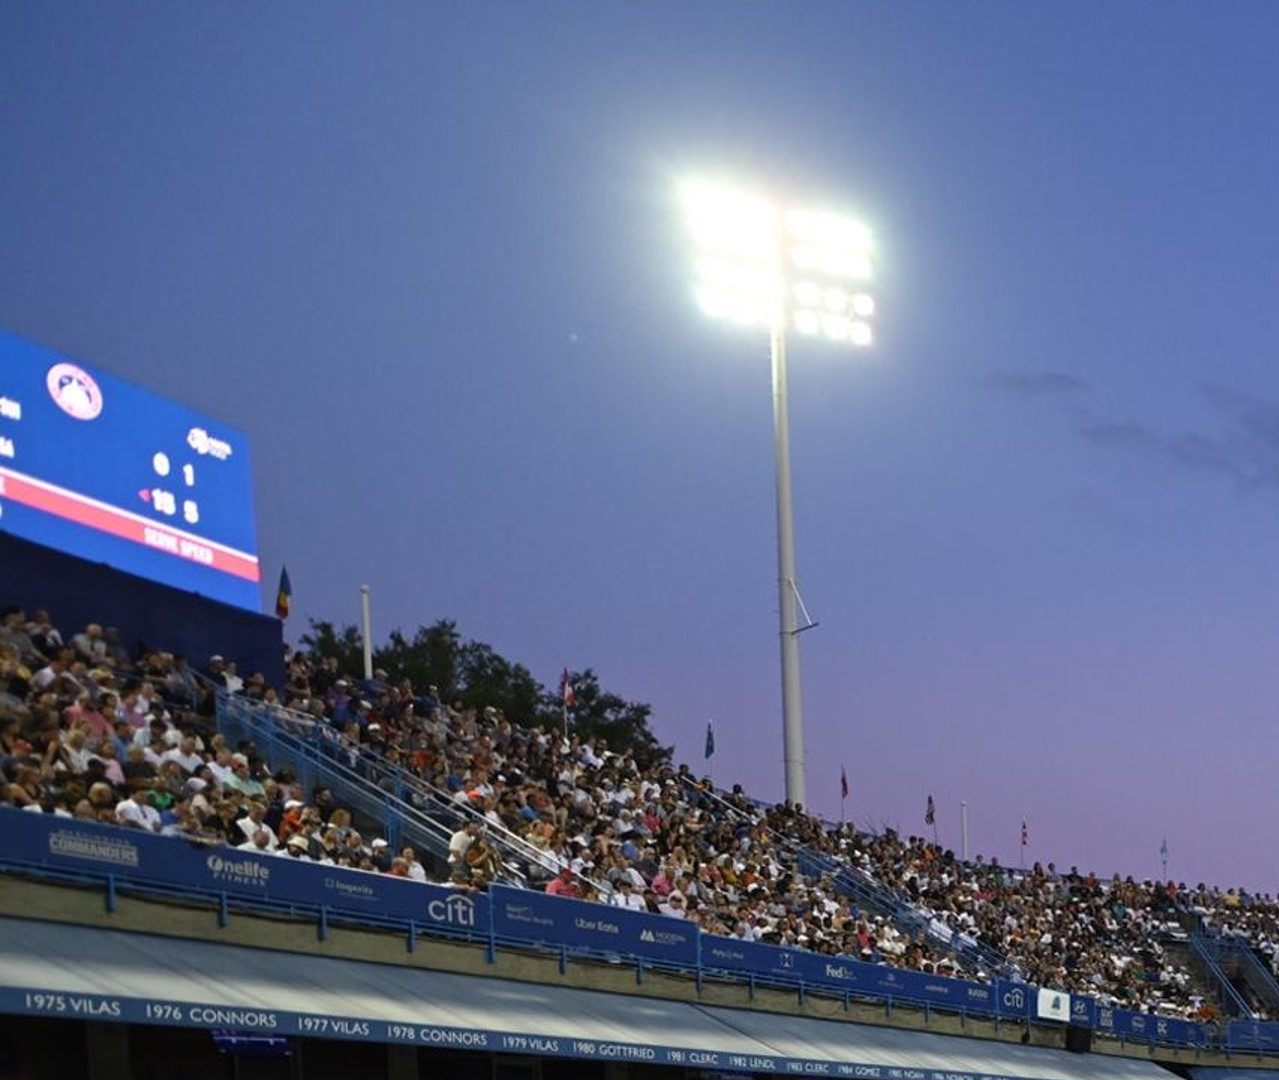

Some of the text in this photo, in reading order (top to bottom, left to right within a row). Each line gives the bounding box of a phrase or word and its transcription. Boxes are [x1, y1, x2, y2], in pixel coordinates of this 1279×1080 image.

[153, 452, 194, 486] 0 1
[428, 894, 475, 926] citi
[1003, 988, 1024, 1009] citi
[25, 993, 66, 1011] 1975
[70, 998, 121, 1016] VILAS
[146, 1004, 182, 1020] 1976
[190, 1008, 277, 1027] CONNORS
[298, 1018, 328, 1031] 1977
[331, 1020, 370, 1037] VILAS
[387, 1026, 415, 1040] 1978
[420, 1028, 487, 1046] CONNORS
[502, 1036, 527, 1049] 1979
[528, 1038, 559, 1052] VILAS
[573, 1041, 596, 1054] 1980
[600, 1044, 655, 1060] GOTTFRIED
[667, 1051, 685, 1062] 1981
[689, 1053, 718, 1065] CLERC
[750, 1058, 776, 1070] LENDL
